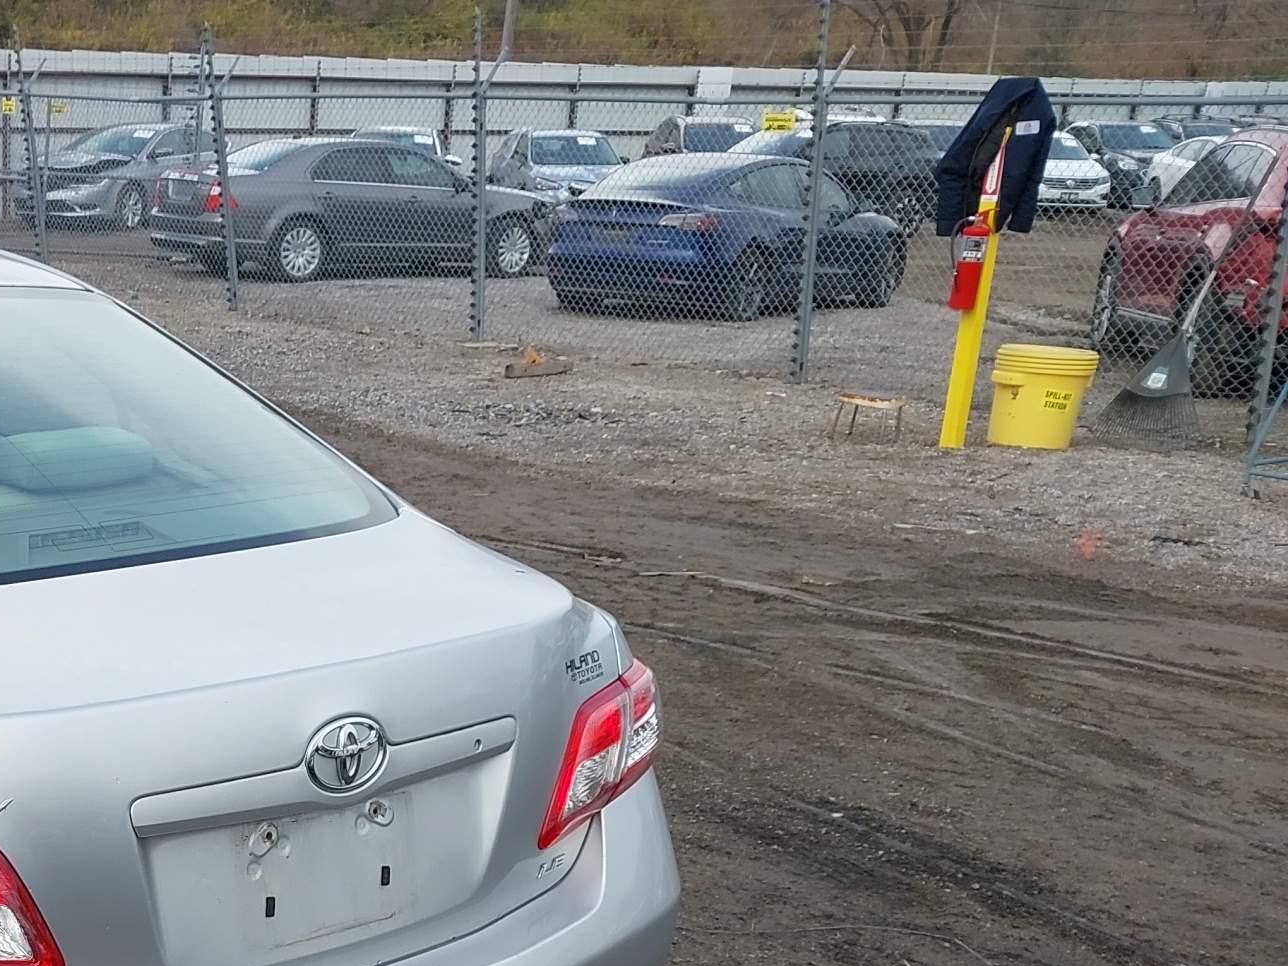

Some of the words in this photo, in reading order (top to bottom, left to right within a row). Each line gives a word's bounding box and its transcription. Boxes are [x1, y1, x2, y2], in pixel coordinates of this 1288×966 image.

[1043, 400, 1068, 411] STATION
[565, 649, 600, 675] HILAND
[576, 663, 603, 680] TOYOTA
